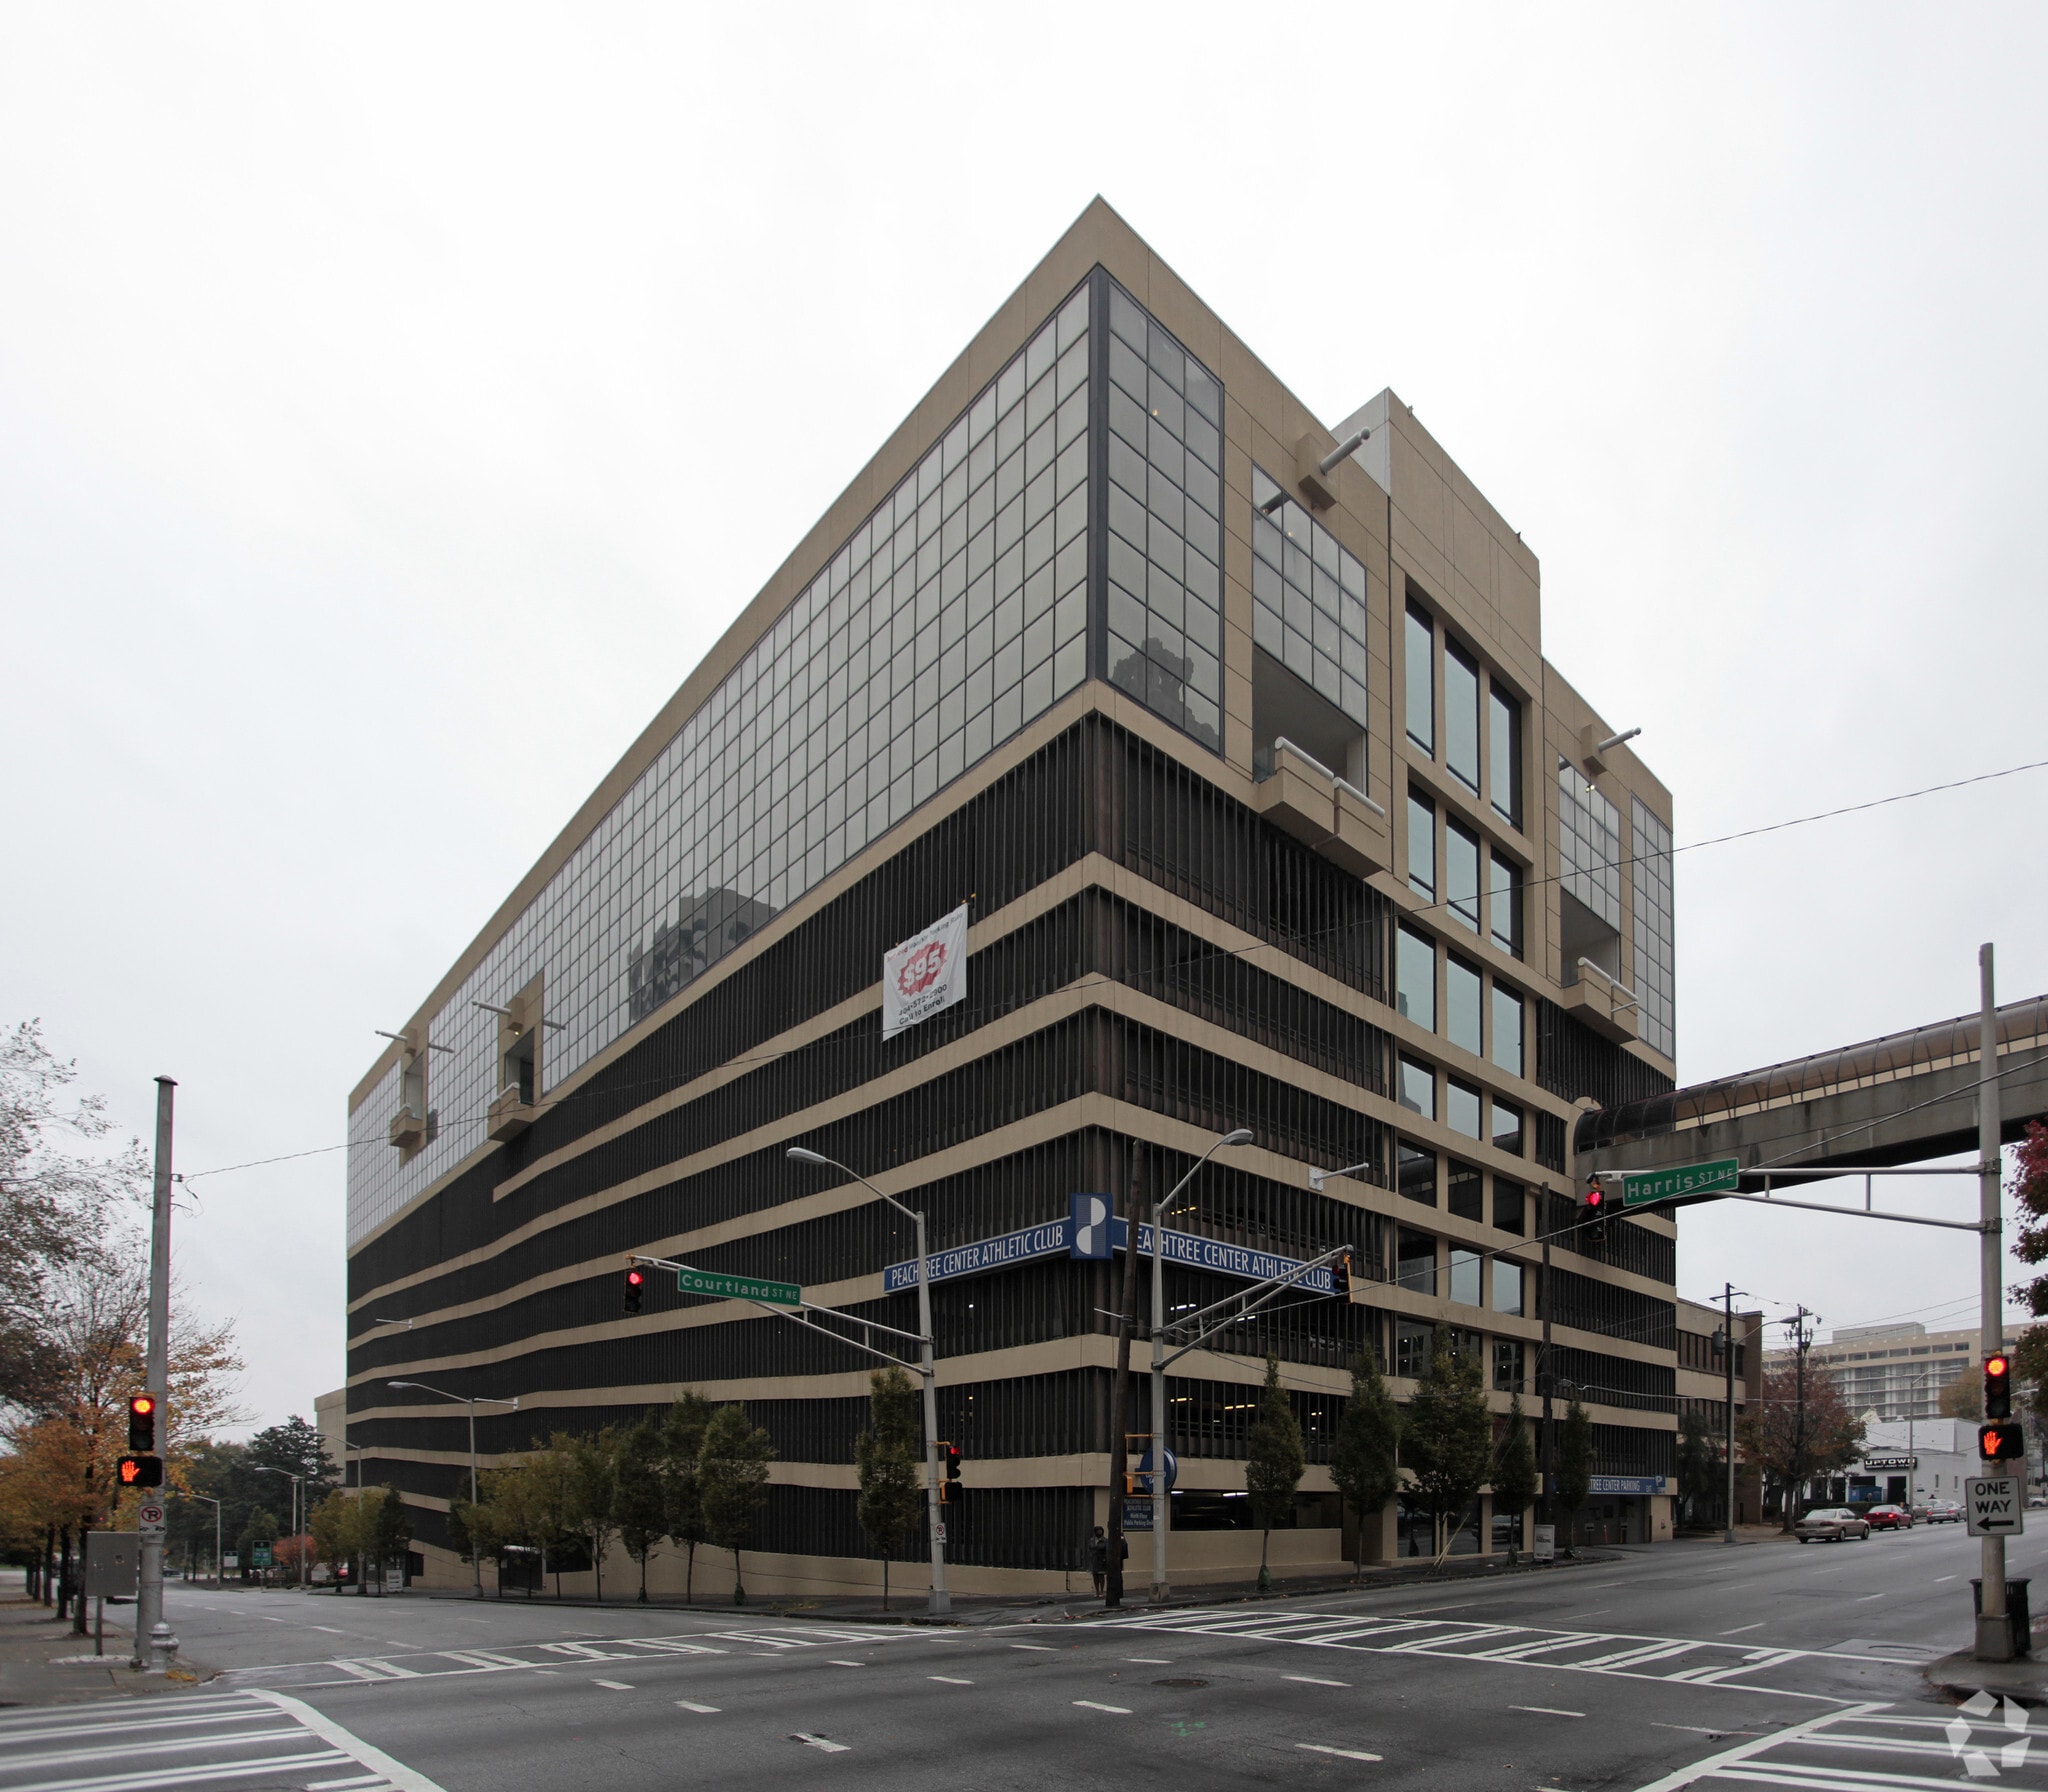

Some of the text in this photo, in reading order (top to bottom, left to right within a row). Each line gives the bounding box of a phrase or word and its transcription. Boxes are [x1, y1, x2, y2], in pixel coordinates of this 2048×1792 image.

[903, 949, 941, 988] $95
[899, 1012, 914, 1025] Call
[1627, 1168, 1734, 1198] Harris ST NE
[892, 1225, 1064, 1287] PEACHREE CENTER ATHLETIC CLUB
[1126, 1225, 1201, 1262] EAHTREE
[1204, 1243, 1249, 1271] CENTER
[1305, 1268, 1331, 1290] CLUB
[682, 1274, 798, 1301] Courtland ST NE
[1602, 1479, 1620, 1491] CENTER
[1620, 1479, 1641, 1492] PARKING
[1975, 1481, 2010, 1496] ONE
[1975, 1499, 2012, 1514] WAY
